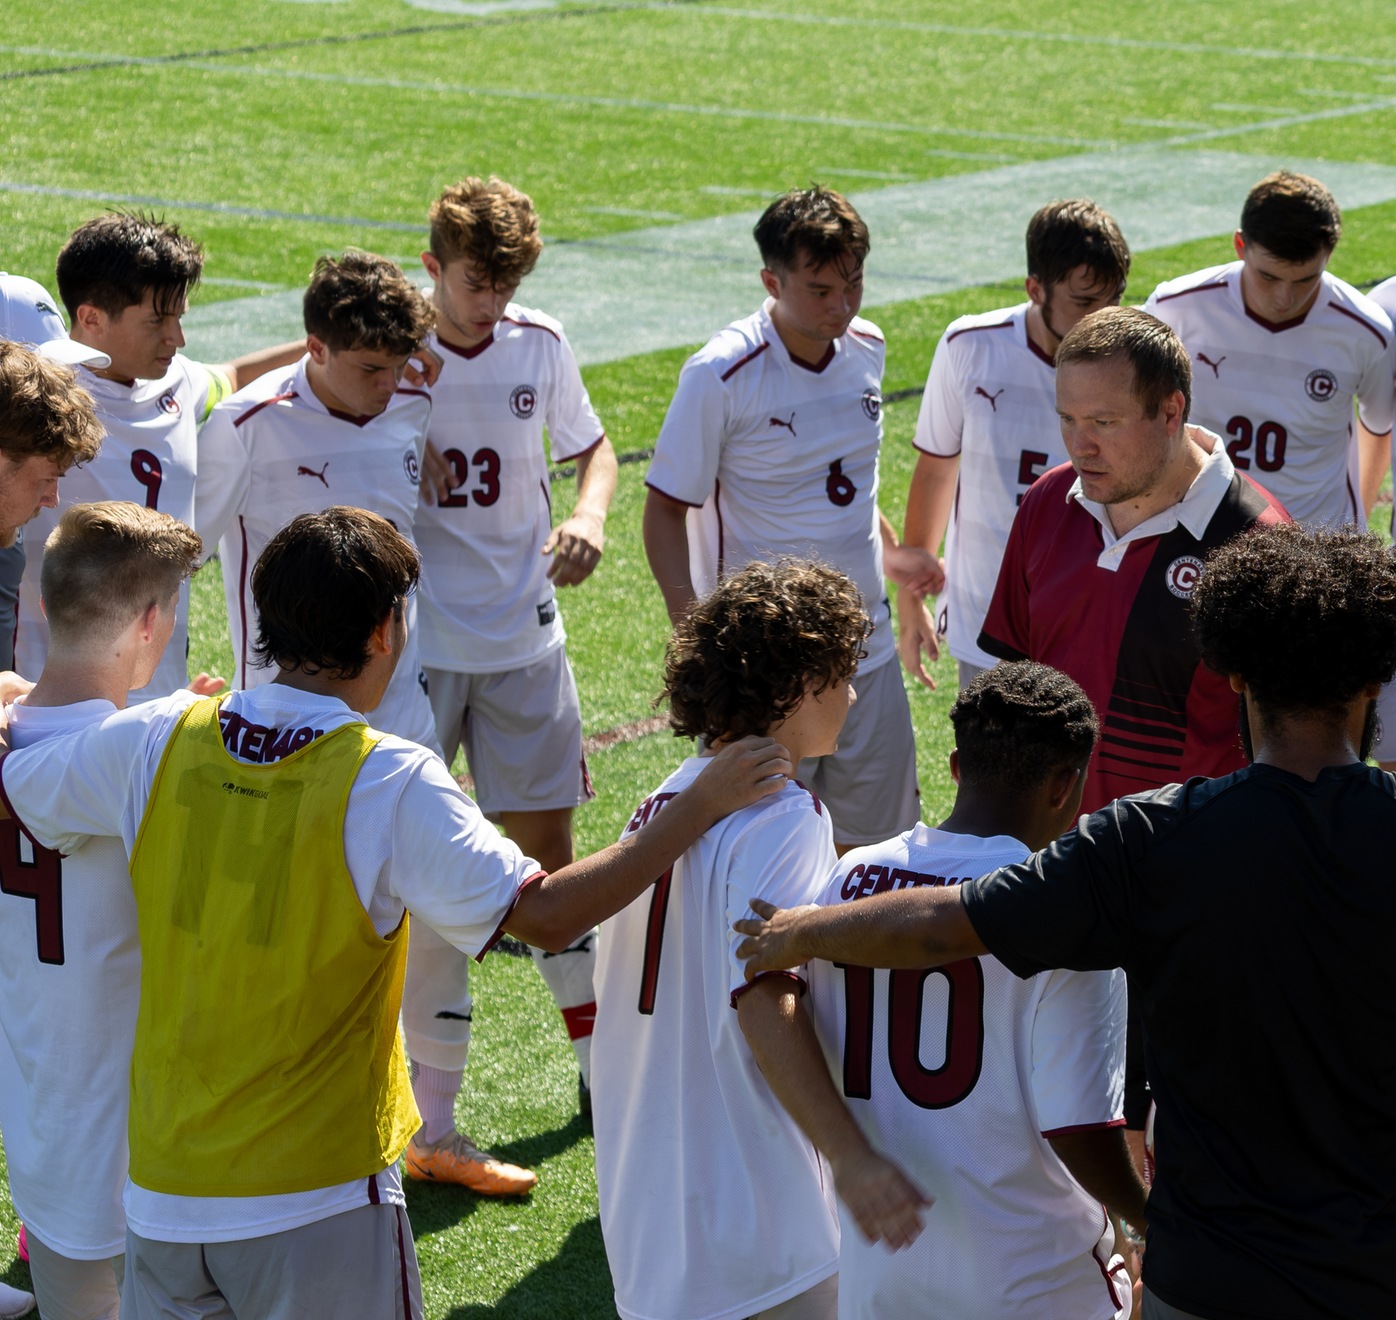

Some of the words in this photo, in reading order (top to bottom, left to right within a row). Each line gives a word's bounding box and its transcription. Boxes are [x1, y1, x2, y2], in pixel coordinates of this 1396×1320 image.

[1226, 414, 1287, 473] 20
[131, 448, 163, 511] 9
[437, 447, 501, 508] 23
[825, 456, 857, 507] 6
[832, 953, 985, 1110] 10
